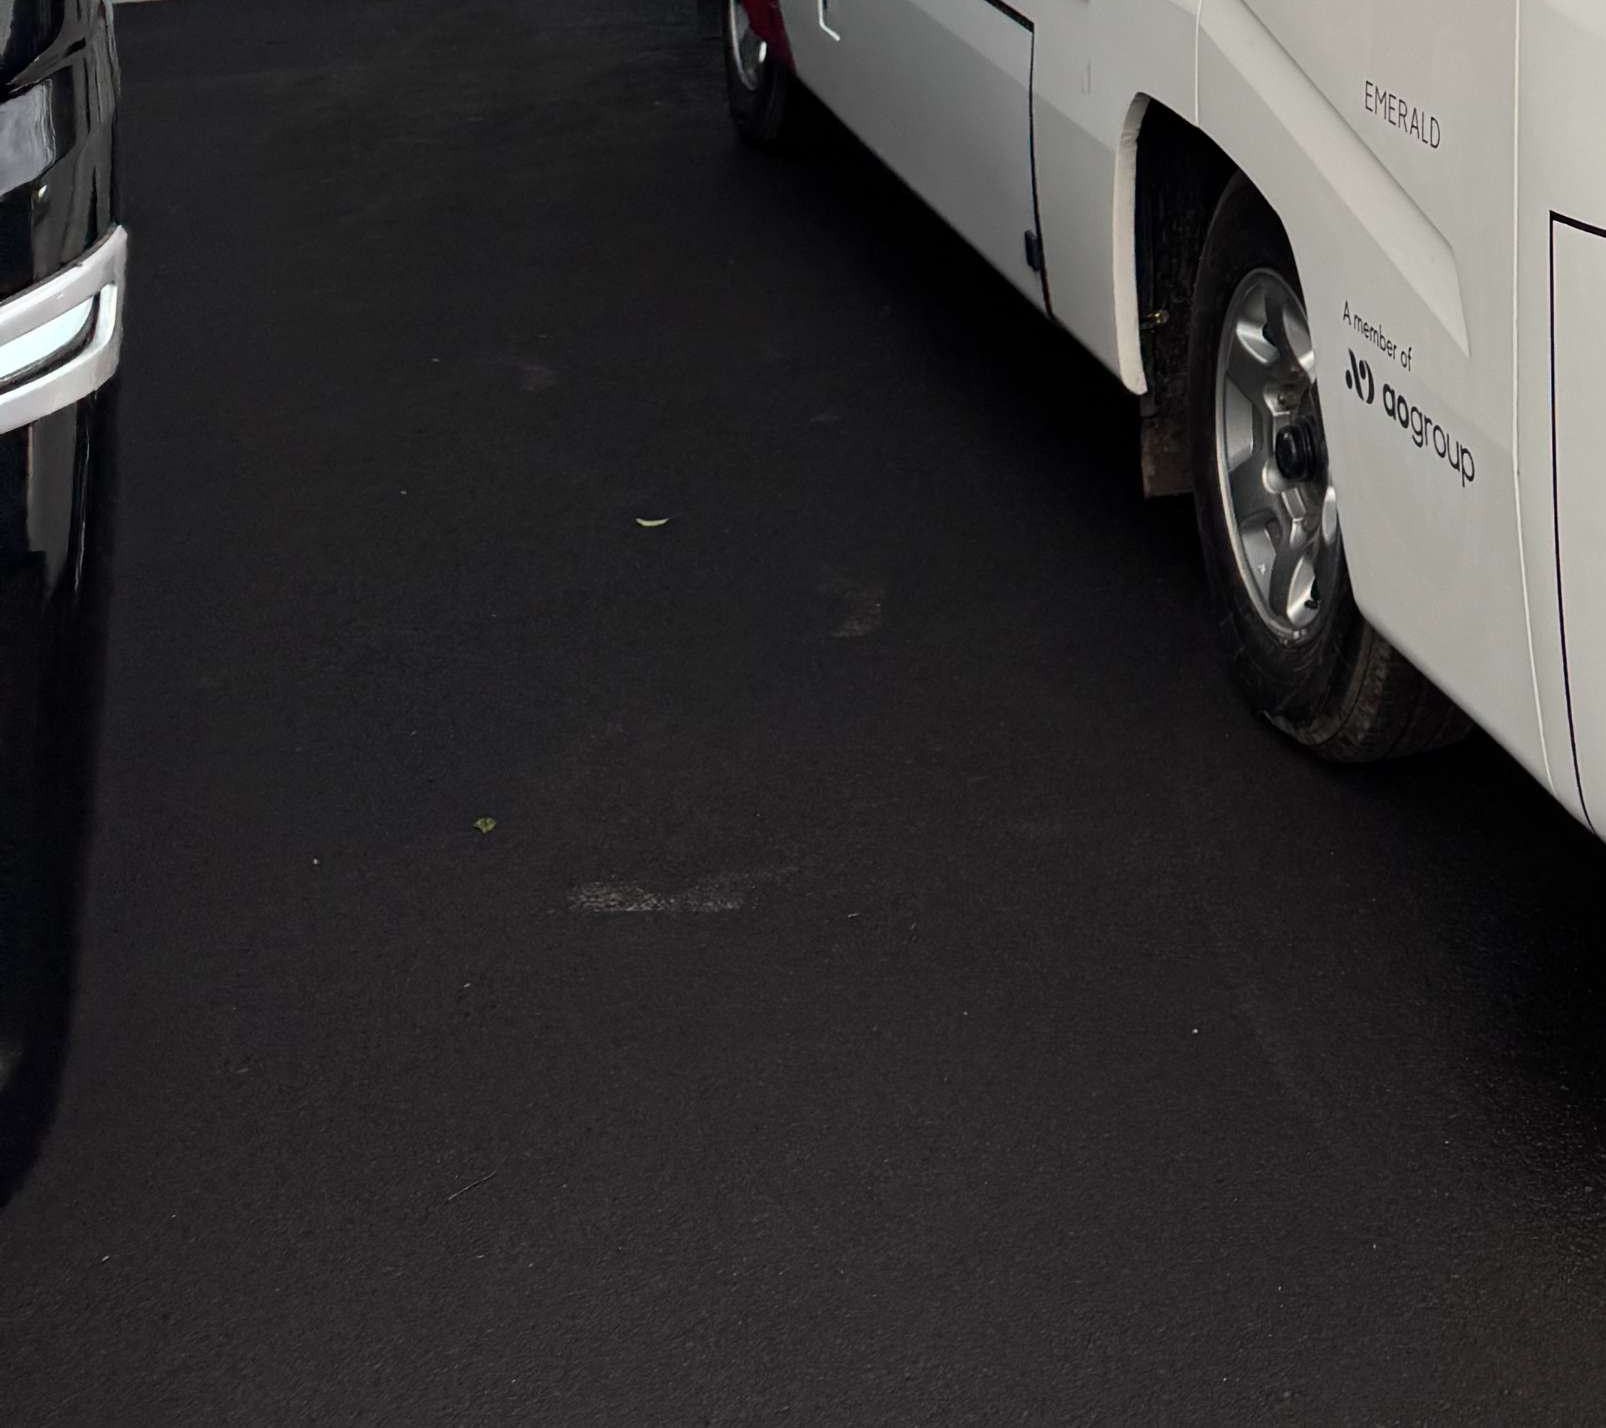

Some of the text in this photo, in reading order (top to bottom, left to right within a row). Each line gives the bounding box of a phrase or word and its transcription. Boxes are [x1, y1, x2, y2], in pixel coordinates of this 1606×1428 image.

[1364, 80, 1441, 149] EMERALD
[1342, 300, 1412, 373] A member of
[1382, 383, 1475, 488] aogroup
